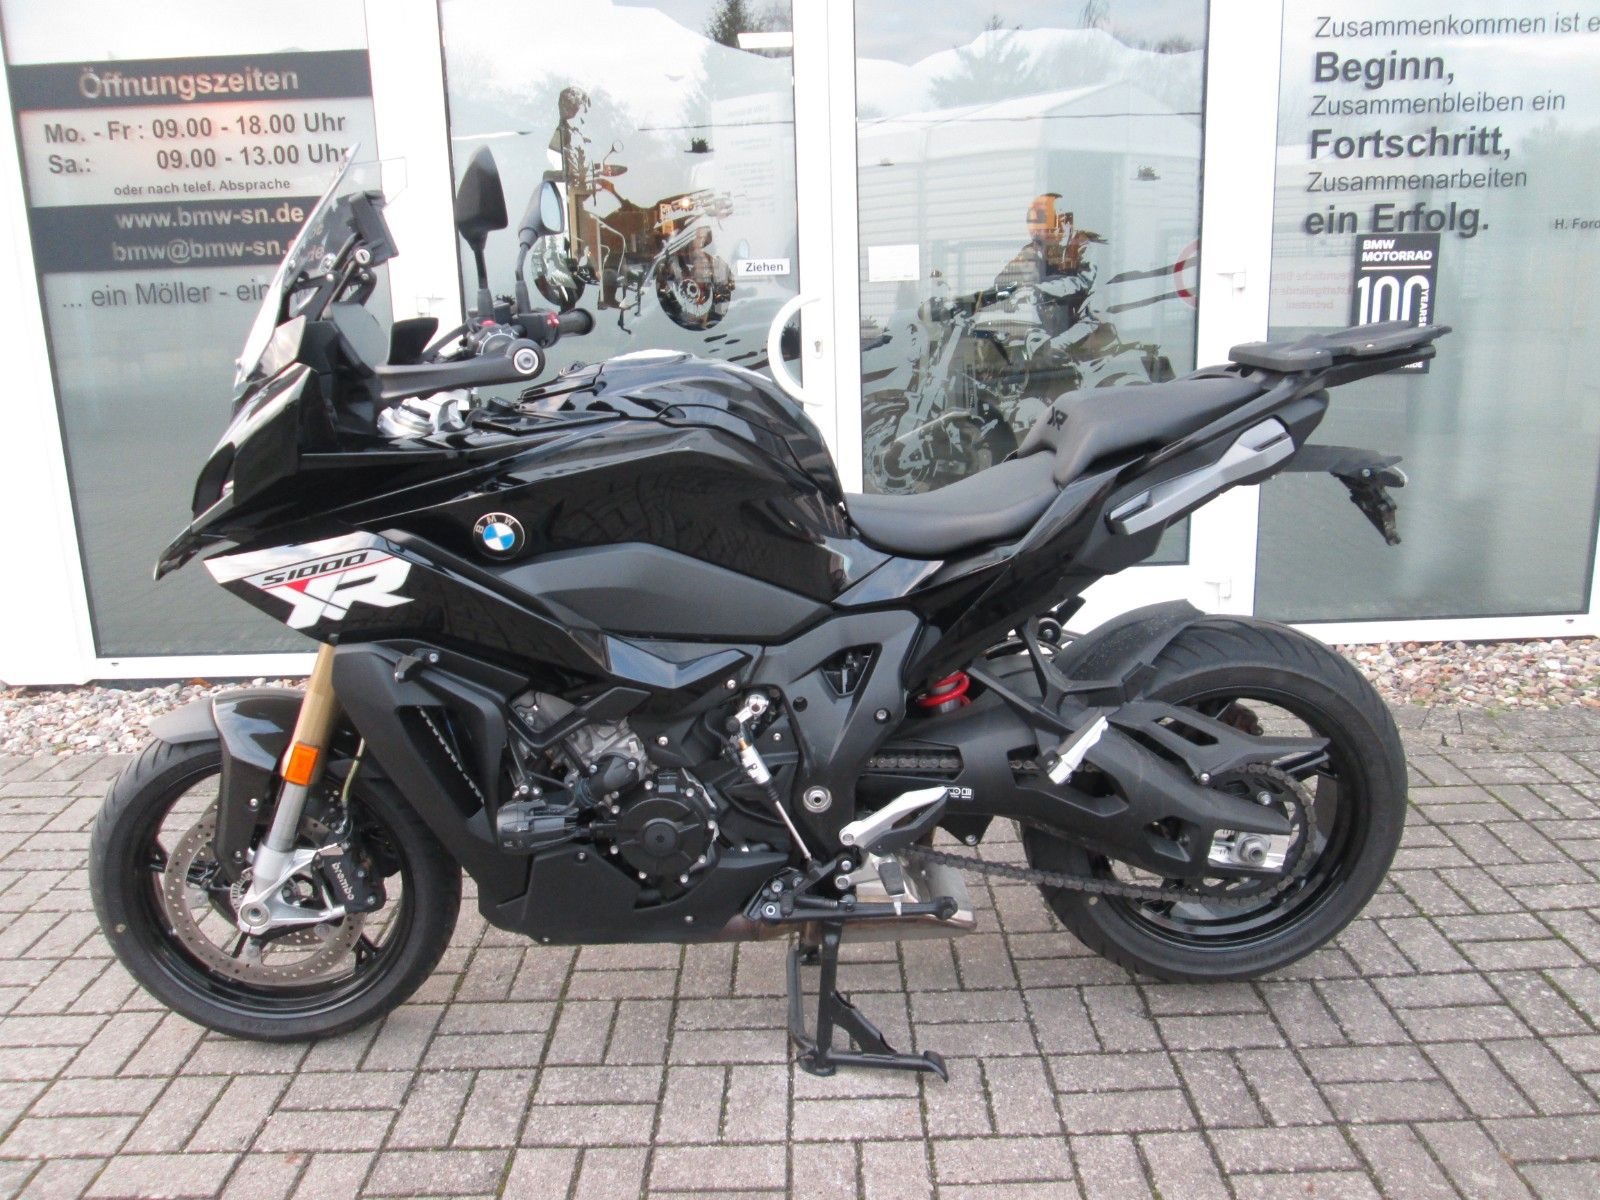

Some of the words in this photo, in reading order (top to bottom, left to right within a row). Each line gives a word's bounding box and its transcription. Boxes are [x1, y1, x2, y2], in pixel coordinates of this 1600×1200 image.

[1315, 14, 1546, 38] Zusammenkommen
[1554, 11, 1579, 33] ist
[79, 66, 300, 99] Öffnungszeiten
[1314, 50, 1454, 90] Beginn,
[1310, 92, 1523, 116] Zusammenbleiben
[1532, 89, 1566, 111] ein
[44, 122, 86, 144] Mo.
[152, 117, 212, 139] 09.00
[236, 113, 296, 135] 18.00
[304, 112, 346, 132] Uhr
[1310, 126, 1511, 160] Fortschritt,
[48, 154, 91, 174] Sa.:
[156, 148, 216, 170] 09.00
[240, 145, 299, 166] 13.00
[113, 183, 143, 197] oder
[148, 181, 178, 196] nach
[182, 179, 215, 194] telef.
[219, 177, 291, 195] Absprache
[1305, 168, 1527, 193] Zusammenarbeiten
[115, 203, 304, 231] www.bmw-sn.de
[1305, 205, 1358, 235] ein
[1371, 202, 1490, 238] Erfolg.
[1554, 218, 1568, 230] H.
[1362, 250, 1432, 262] MOTORRAD
[1363, 239, 1395, 250] BMW
[745, 262, 784, 273] Ziehen
[91, 285, 127, 307] ein
[136, 280, 210, 305] Möller
[1357, 274, 1429, 326] 100
[475, 514, 515, 534] BMW
[262, 552, 368, 586] S1000
[268, 558, 416, 630] XR
[332, 861, 355, 901] brembo
